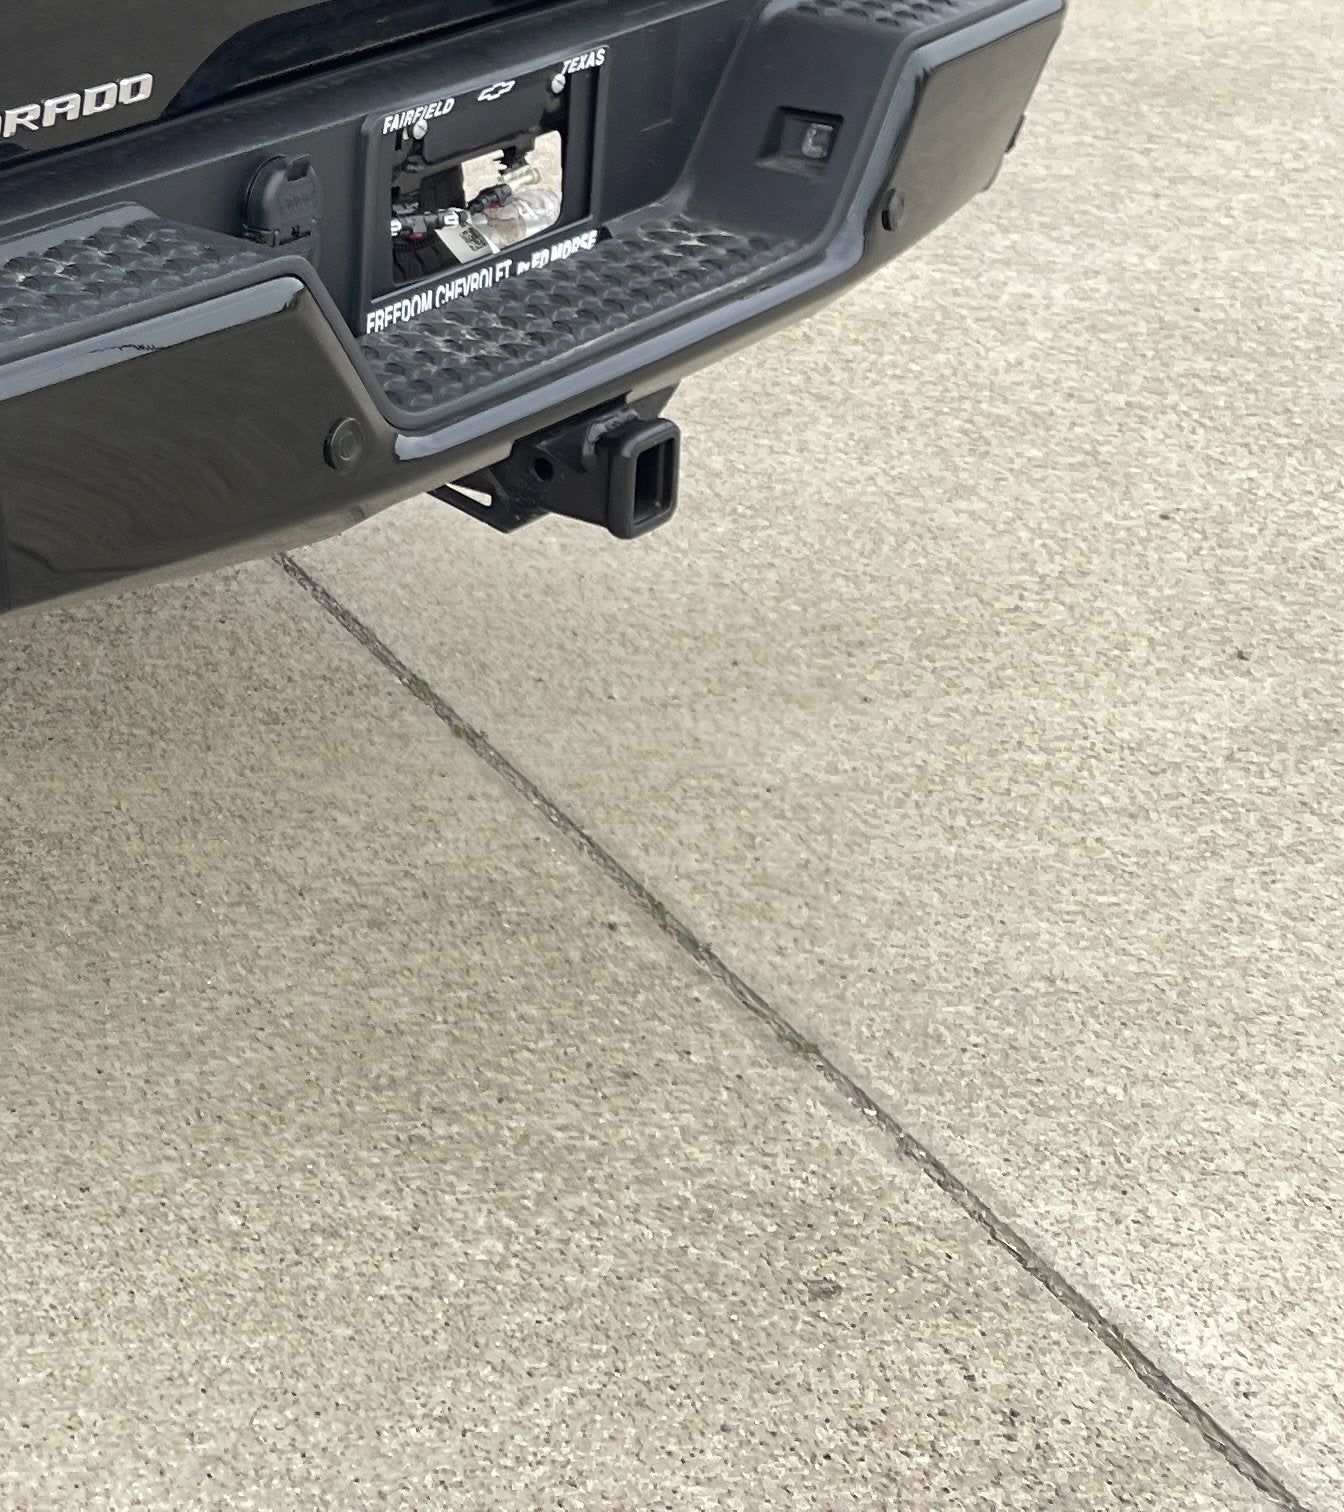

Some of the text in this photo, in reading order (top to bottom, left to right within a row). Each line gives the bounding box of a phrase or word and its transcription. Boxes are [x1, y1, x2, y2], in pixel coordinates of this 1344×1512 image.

[382, 48, 606, 135] FAIRFIELD TEXAS
[366, 290, 433, 335] FREEDOM
